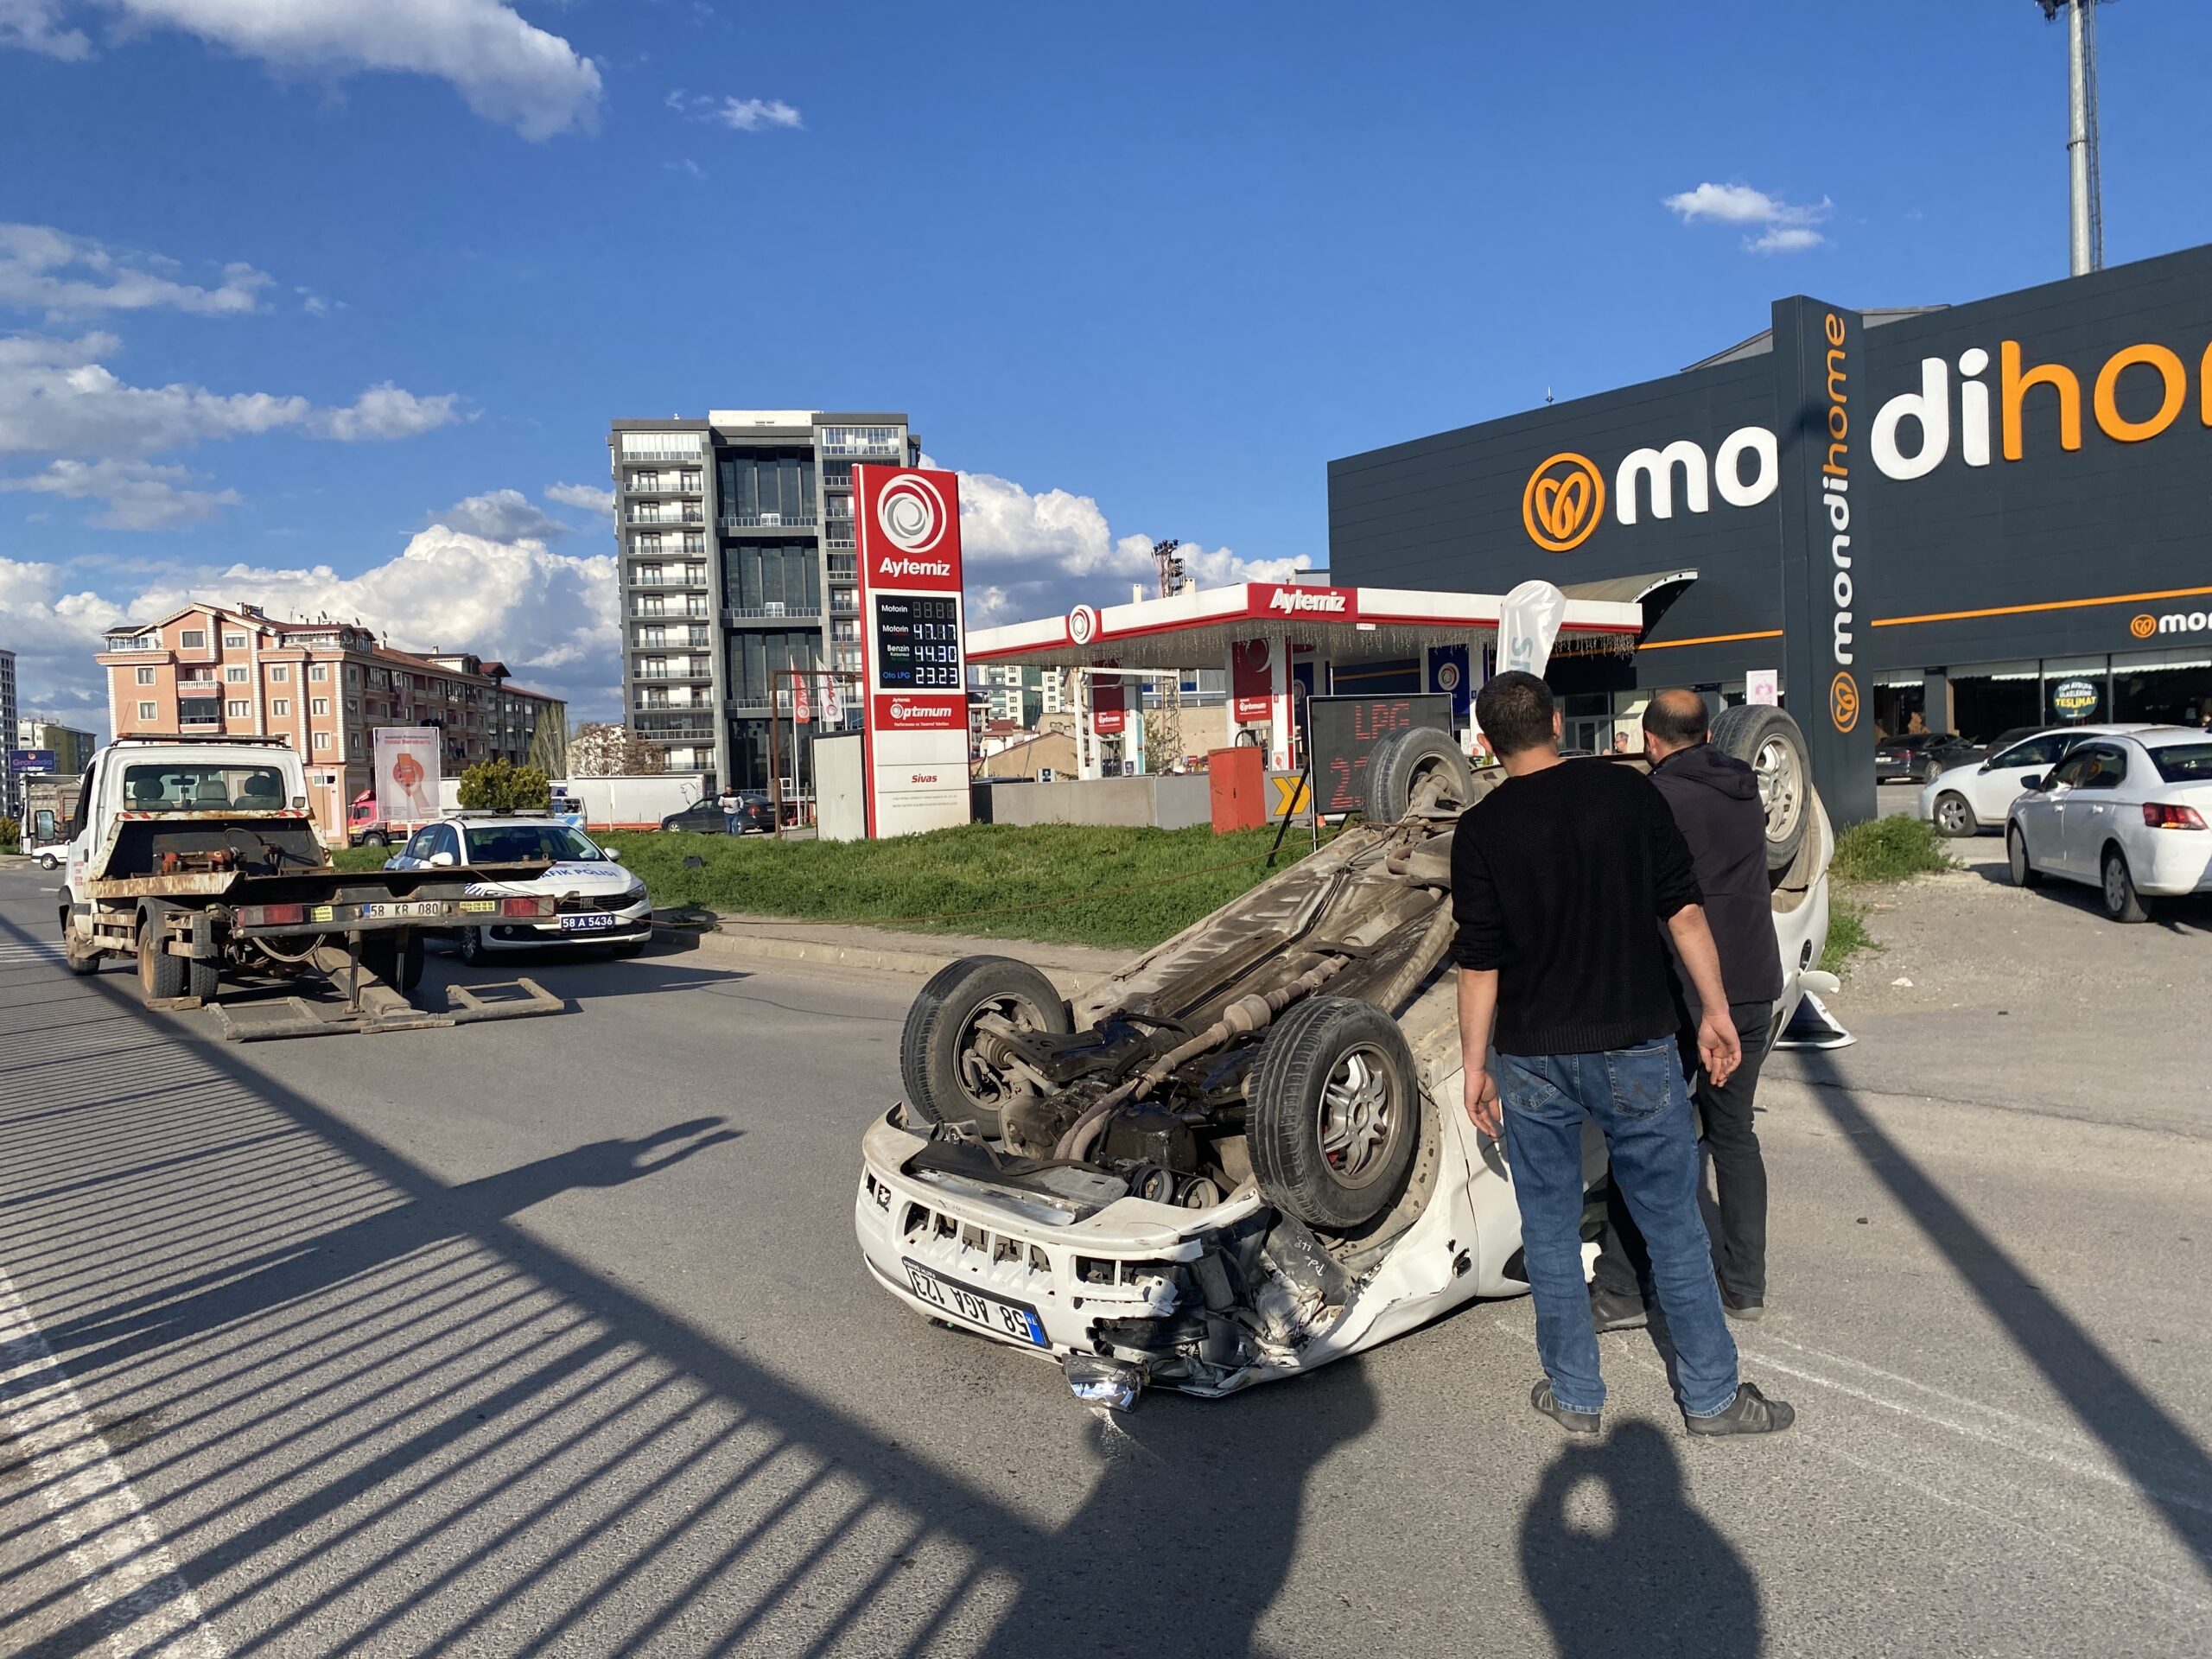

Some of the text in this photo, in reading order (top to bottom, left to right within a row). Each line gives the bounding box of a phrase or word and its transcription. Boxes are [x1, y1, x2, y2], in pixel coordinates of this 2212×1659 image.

[1871, 340, 2212, 480] diho
[1822, 314, 1854, 665] mondihome
[879, 556, 950, 578] Aytemiz
[881, 604, 908, 613] Motorin
[1269, 588, 1345, 614] Aytemiz
[882, 623, 956, 640] Motorin 47.17
[2158, 612, 2212, 634] mo
[887, 644, 957, 663] Benzin 44.30
[916, 667, 958, 684] 23.23
[890, 703, 952, 721] Optimum
[1355, 702, 1410, 740] LPG
[912, 772, 938, 783] Sivas
[371, 905, 385, 917] 58
[418, 903, 439, 915] 080
[563, 916, 613, 928] 58 A 5436
[911, 1270, 945, 1306] 123
[950, 1287, 989, 1324] AGA
[999, 1306, 1031, 1338] 58
